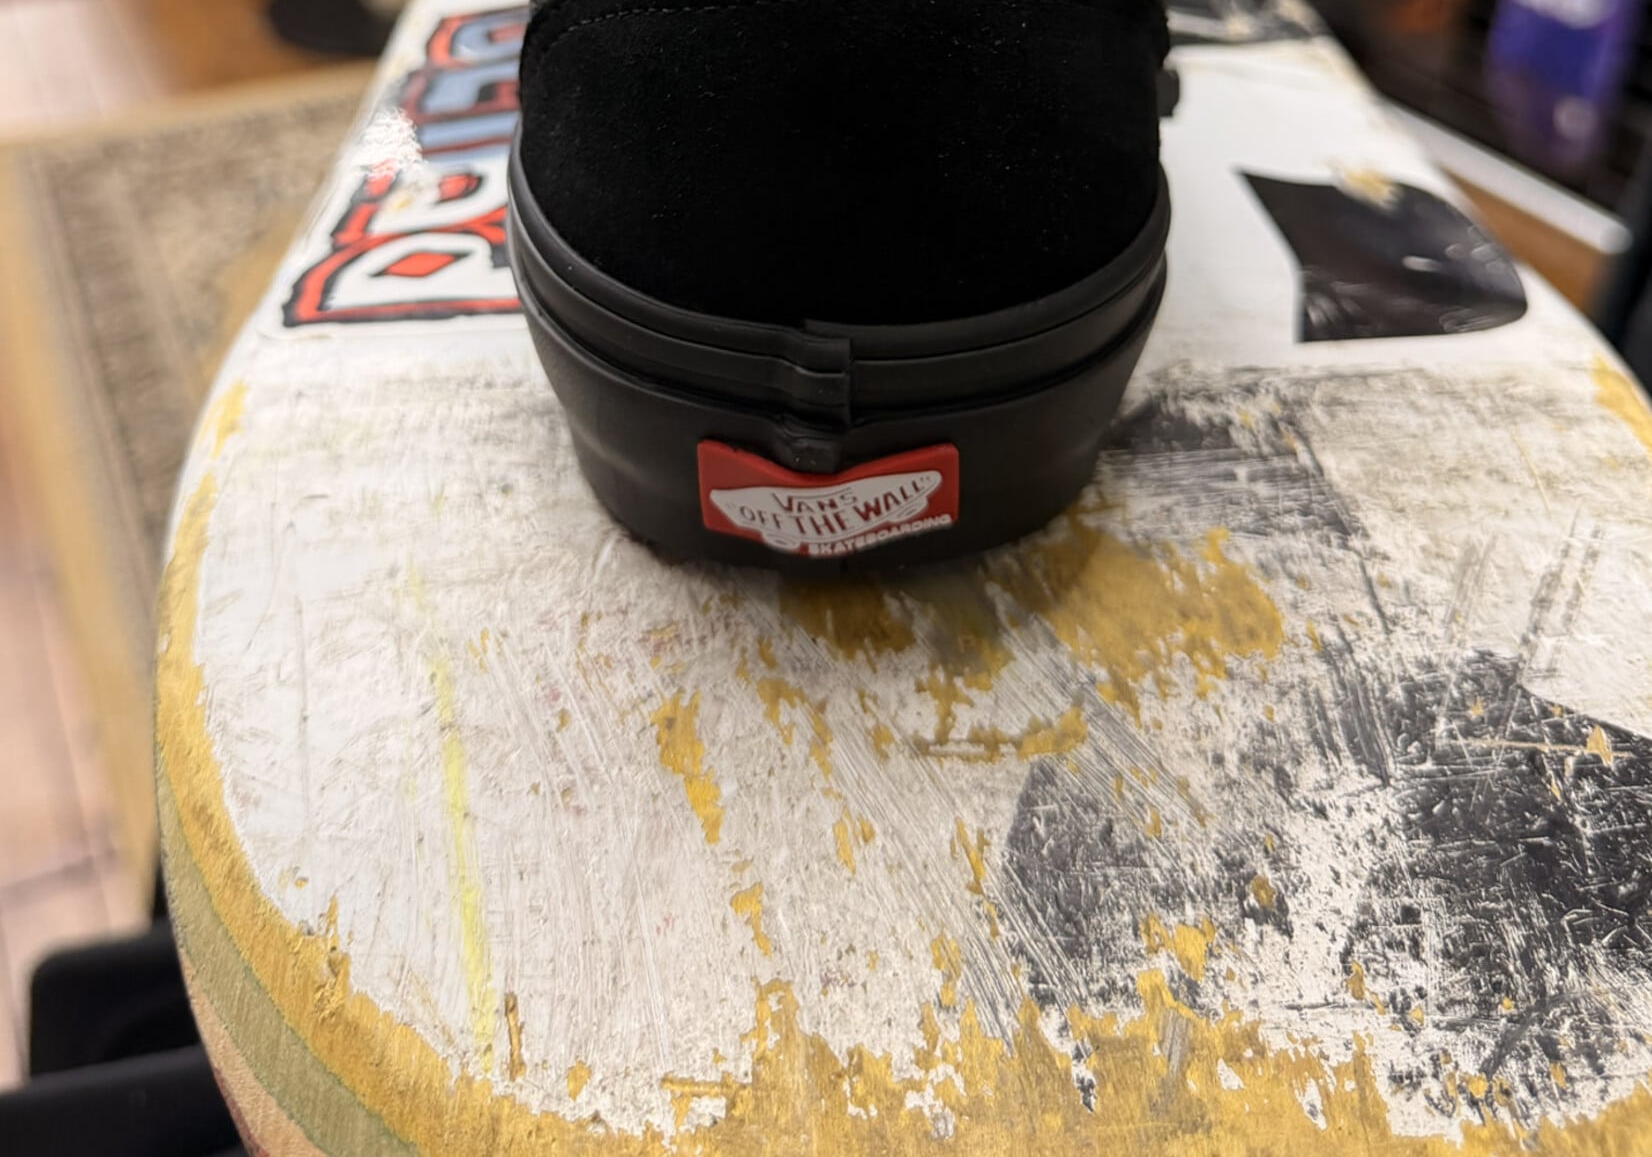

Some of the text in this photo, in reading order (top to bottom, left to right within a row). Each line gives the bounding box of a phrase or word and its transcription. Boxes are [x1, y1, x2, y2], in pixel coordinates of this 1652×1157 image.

[771, 487, 857, 513] VANS
[790, 511, 855, 535] THE
[808, 514, 952, 555] SKATEBOARDING
